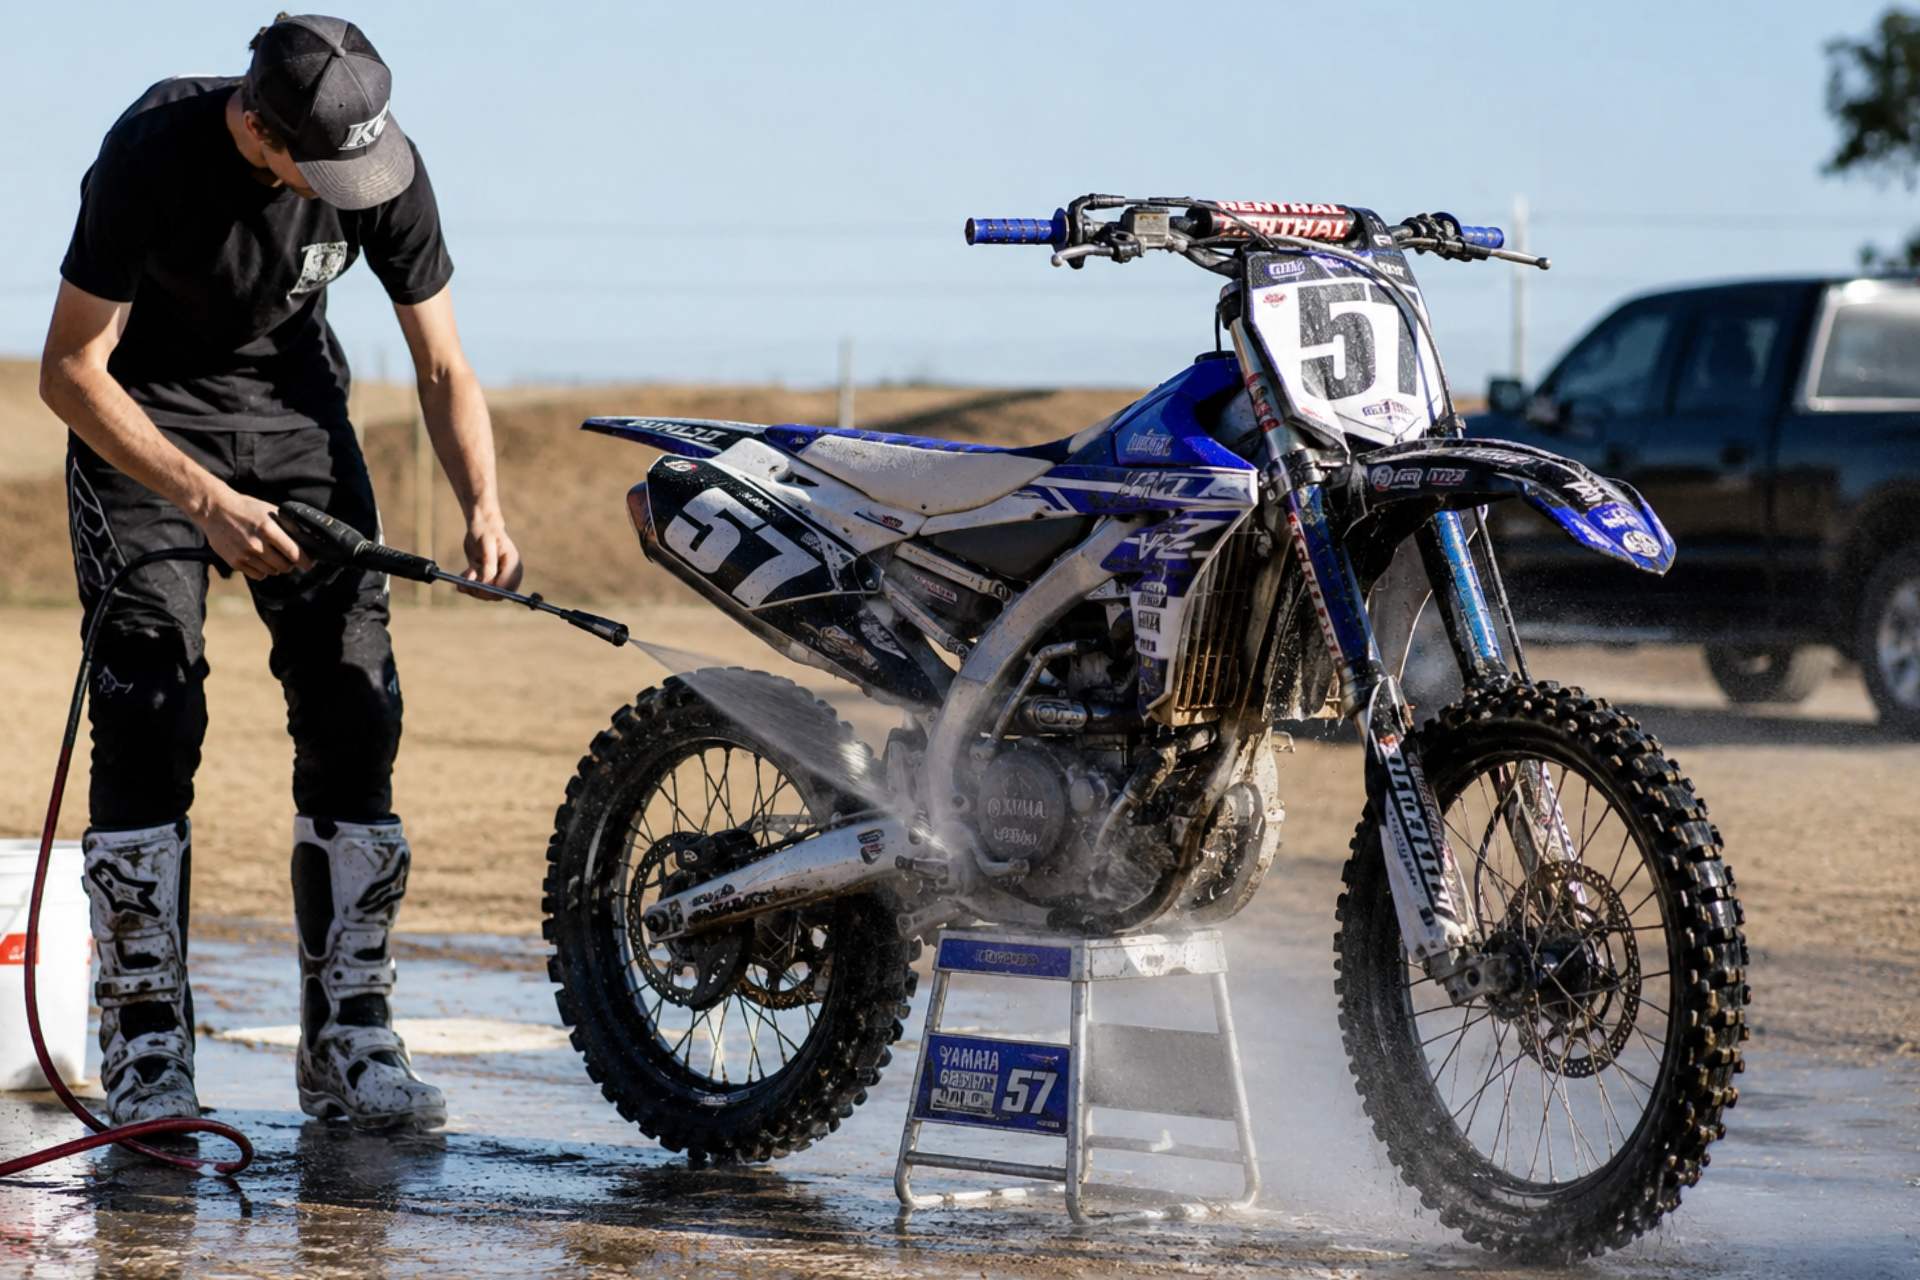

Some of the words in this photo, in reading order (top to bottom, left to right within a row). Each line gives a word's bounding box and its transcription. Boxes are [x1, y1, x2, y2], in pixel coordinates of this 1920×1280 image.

[1298, 281, 1418, 401] 57
[664, 487, 822, 608] 57
[1001, 1068, 1058, 1114] 57
